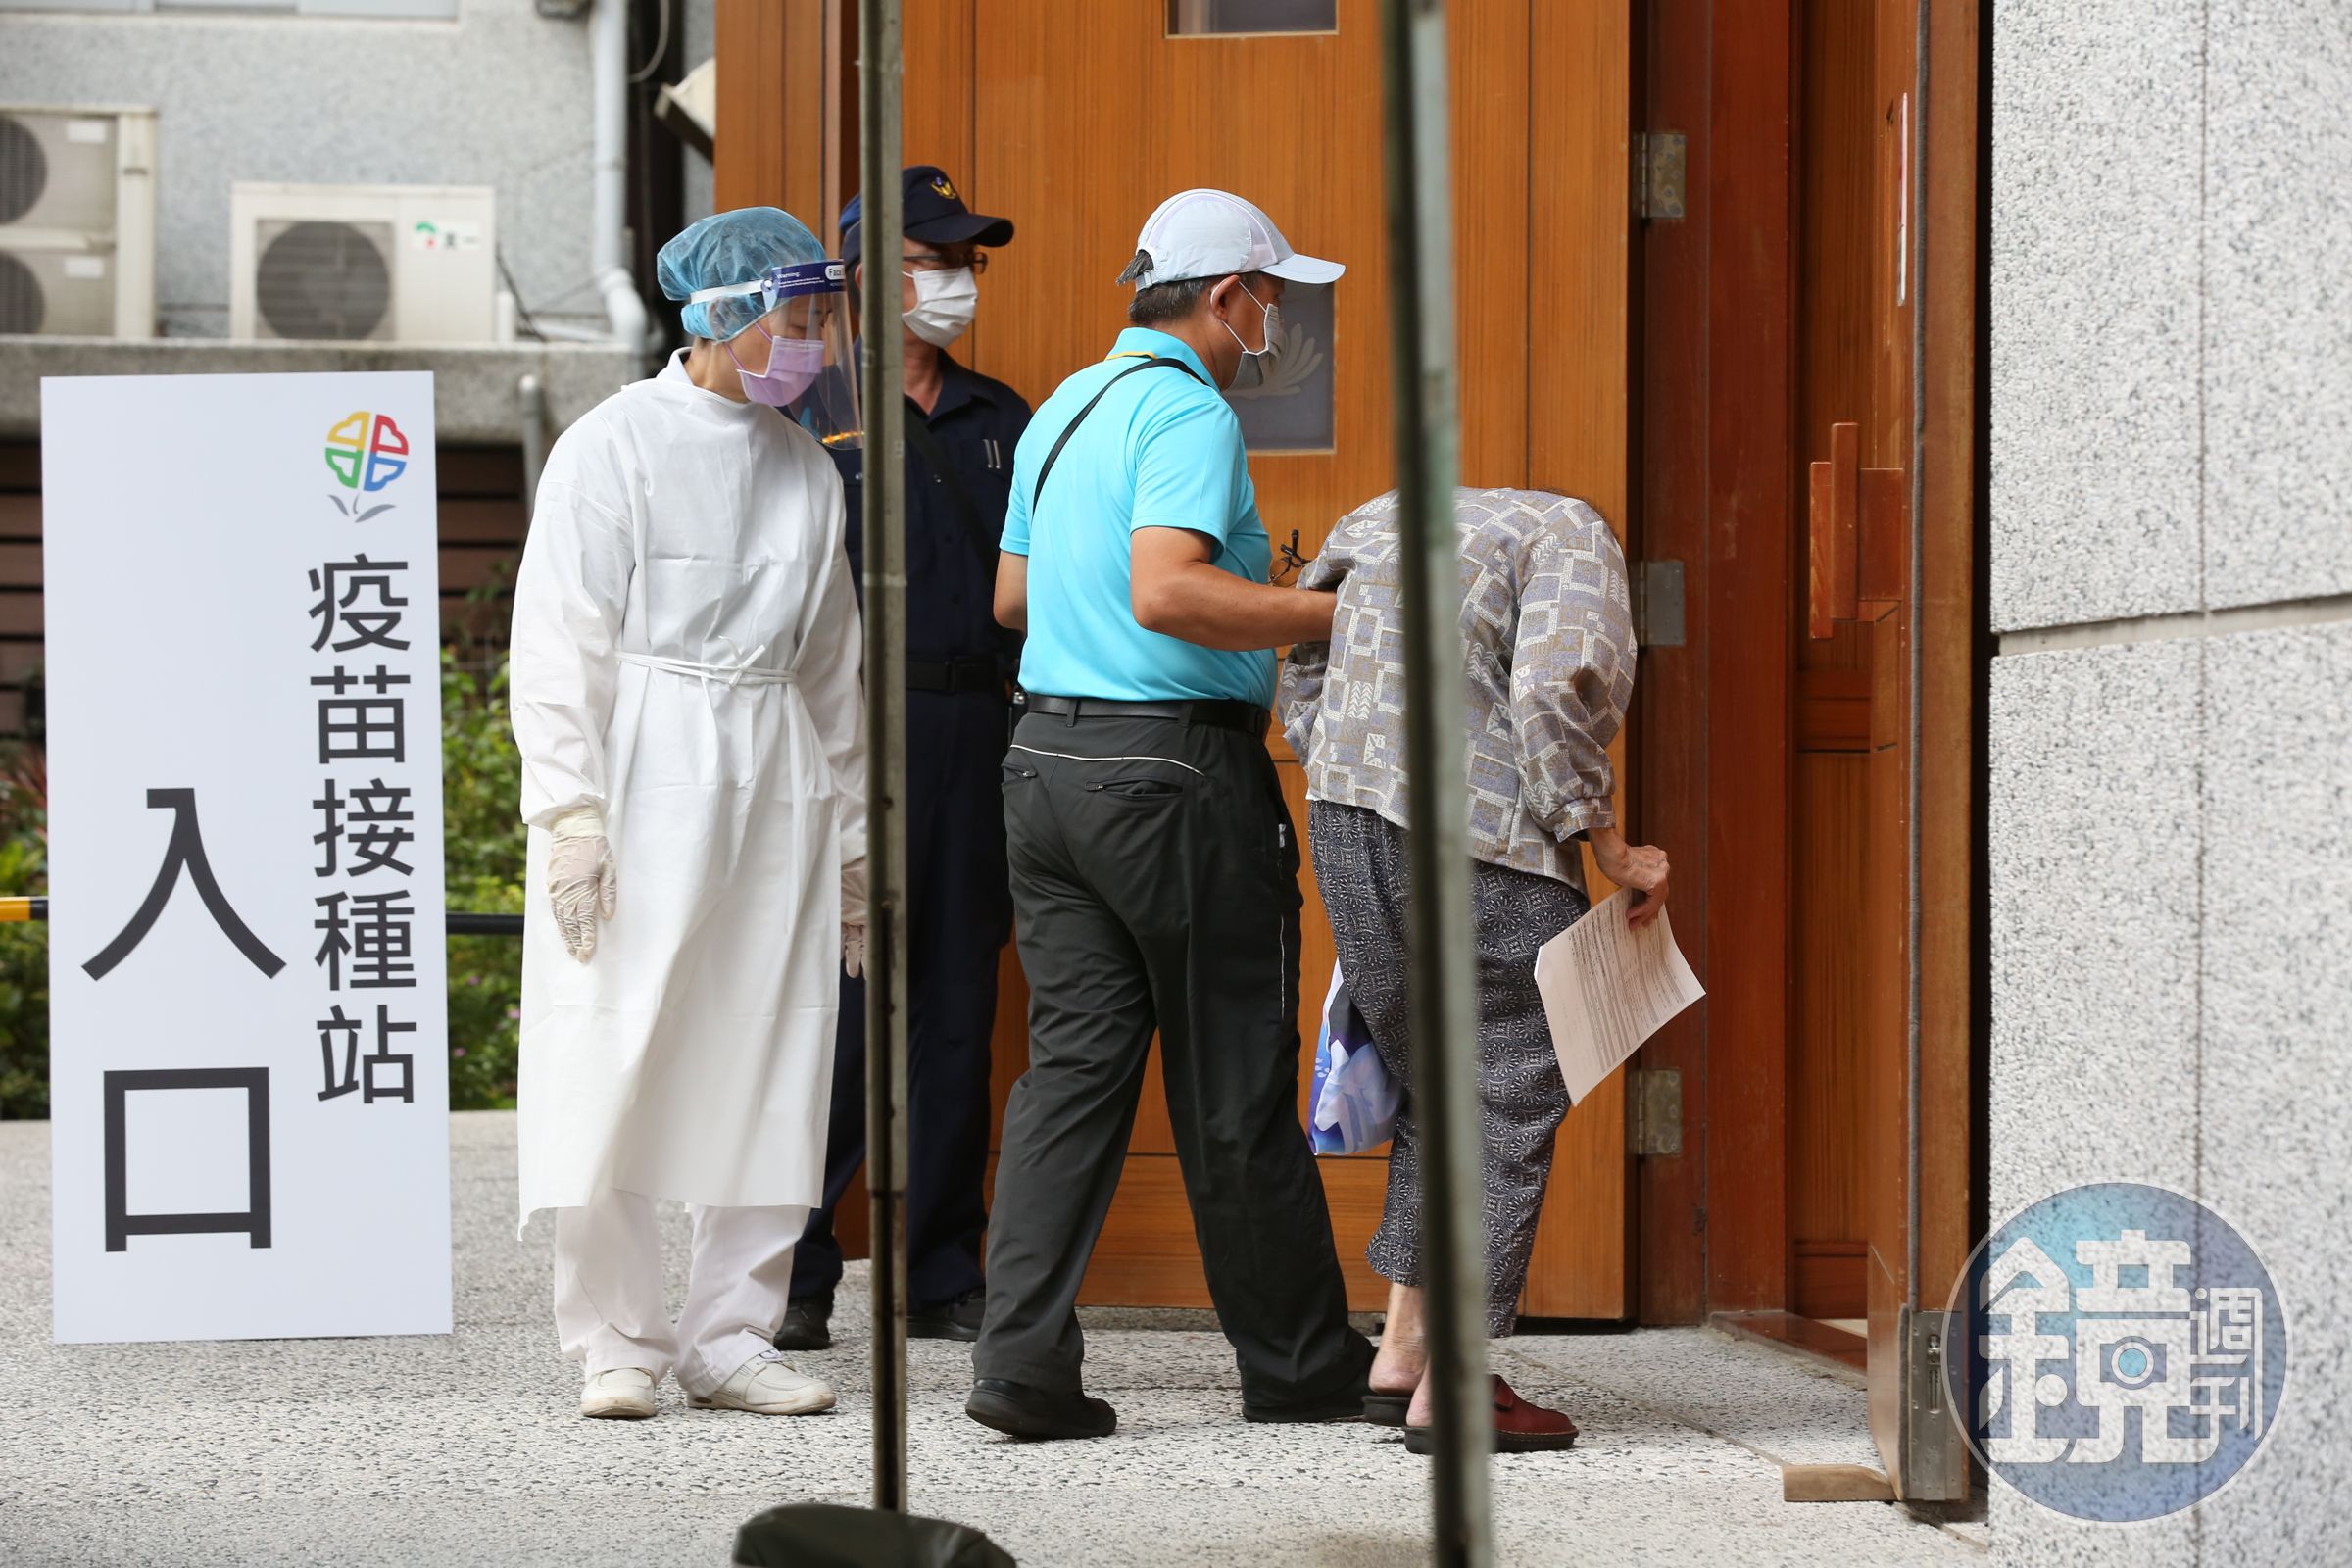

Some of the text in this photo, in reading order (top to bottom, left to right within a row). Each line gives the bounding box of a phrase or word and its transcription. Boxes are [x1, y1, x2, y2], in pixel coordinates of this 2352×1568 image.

[81, 787, 286, 1253] 入口
[308, 553, 416, 1104] 疫苗接種站
